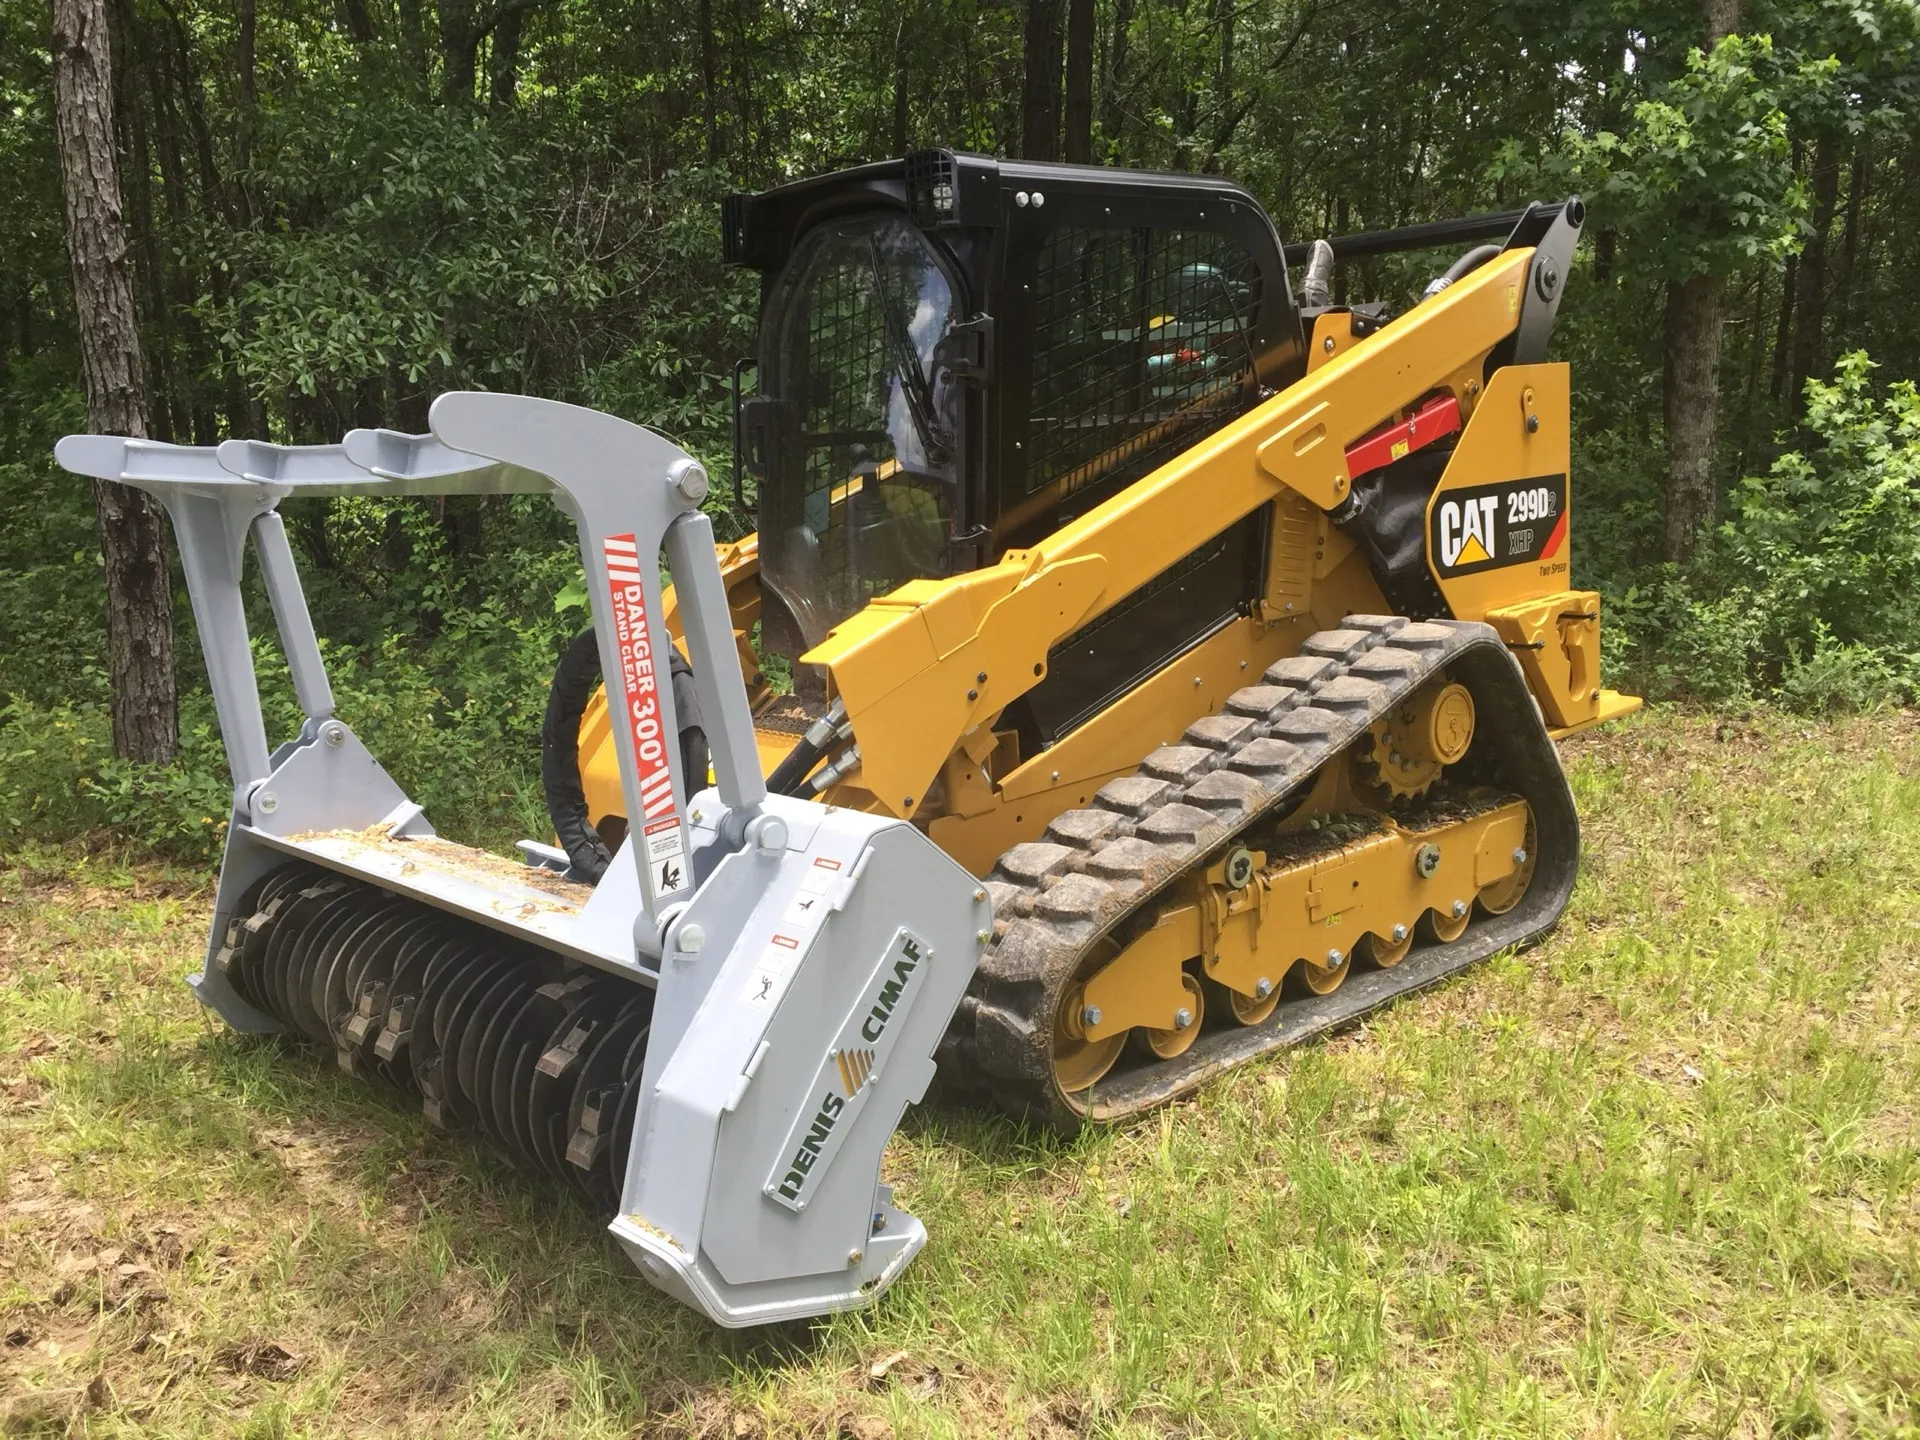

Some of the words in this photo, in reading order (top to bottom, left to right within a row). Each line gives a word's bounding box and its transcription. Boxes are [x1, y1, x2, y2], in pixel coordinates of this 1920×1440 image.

[1440, 495, 1498, 567] CAT
[1508, 529, 1534, 555] XHP
[613, 591, 630, 642] STAND
[624, 584, 655, 695] DANGER
[621, 645, 637, 694] CLEAR
[778, 1092, 845, 1201] DENIS
[861, 938, 921, 1044] CIMAF
